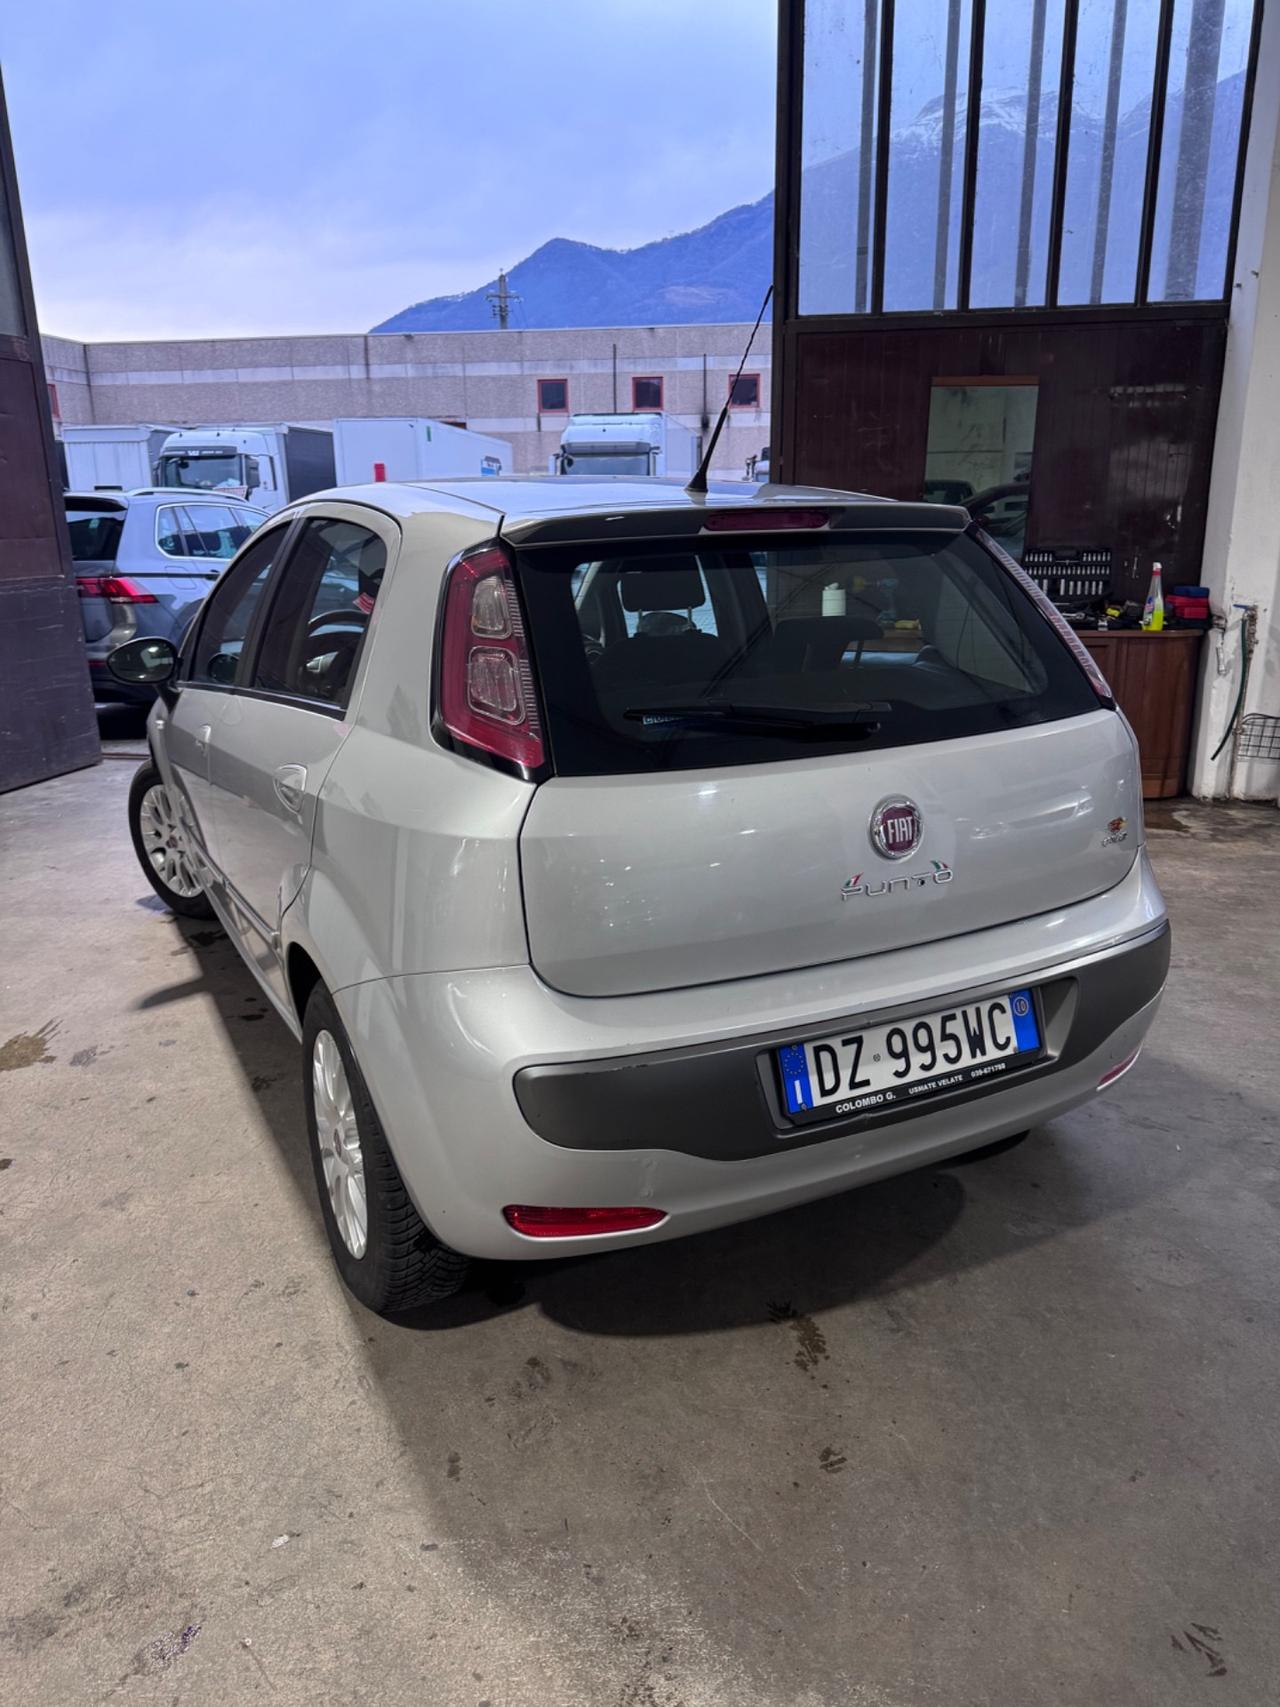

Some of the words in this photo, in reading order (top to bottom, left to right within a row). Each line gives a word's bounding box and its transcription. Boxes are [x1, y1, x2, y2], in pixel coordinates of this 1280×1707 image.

[887, 815, 914, 844] FIAT
[812, 1035, 871, 1098] DZ
[886, 1002, 1012, 1078] 995WC
[794, 1080, 803, 1104] I
[835, 1095, 884, 1113] COLOMBO
[937, 1074, 963, 1087] VELATE
